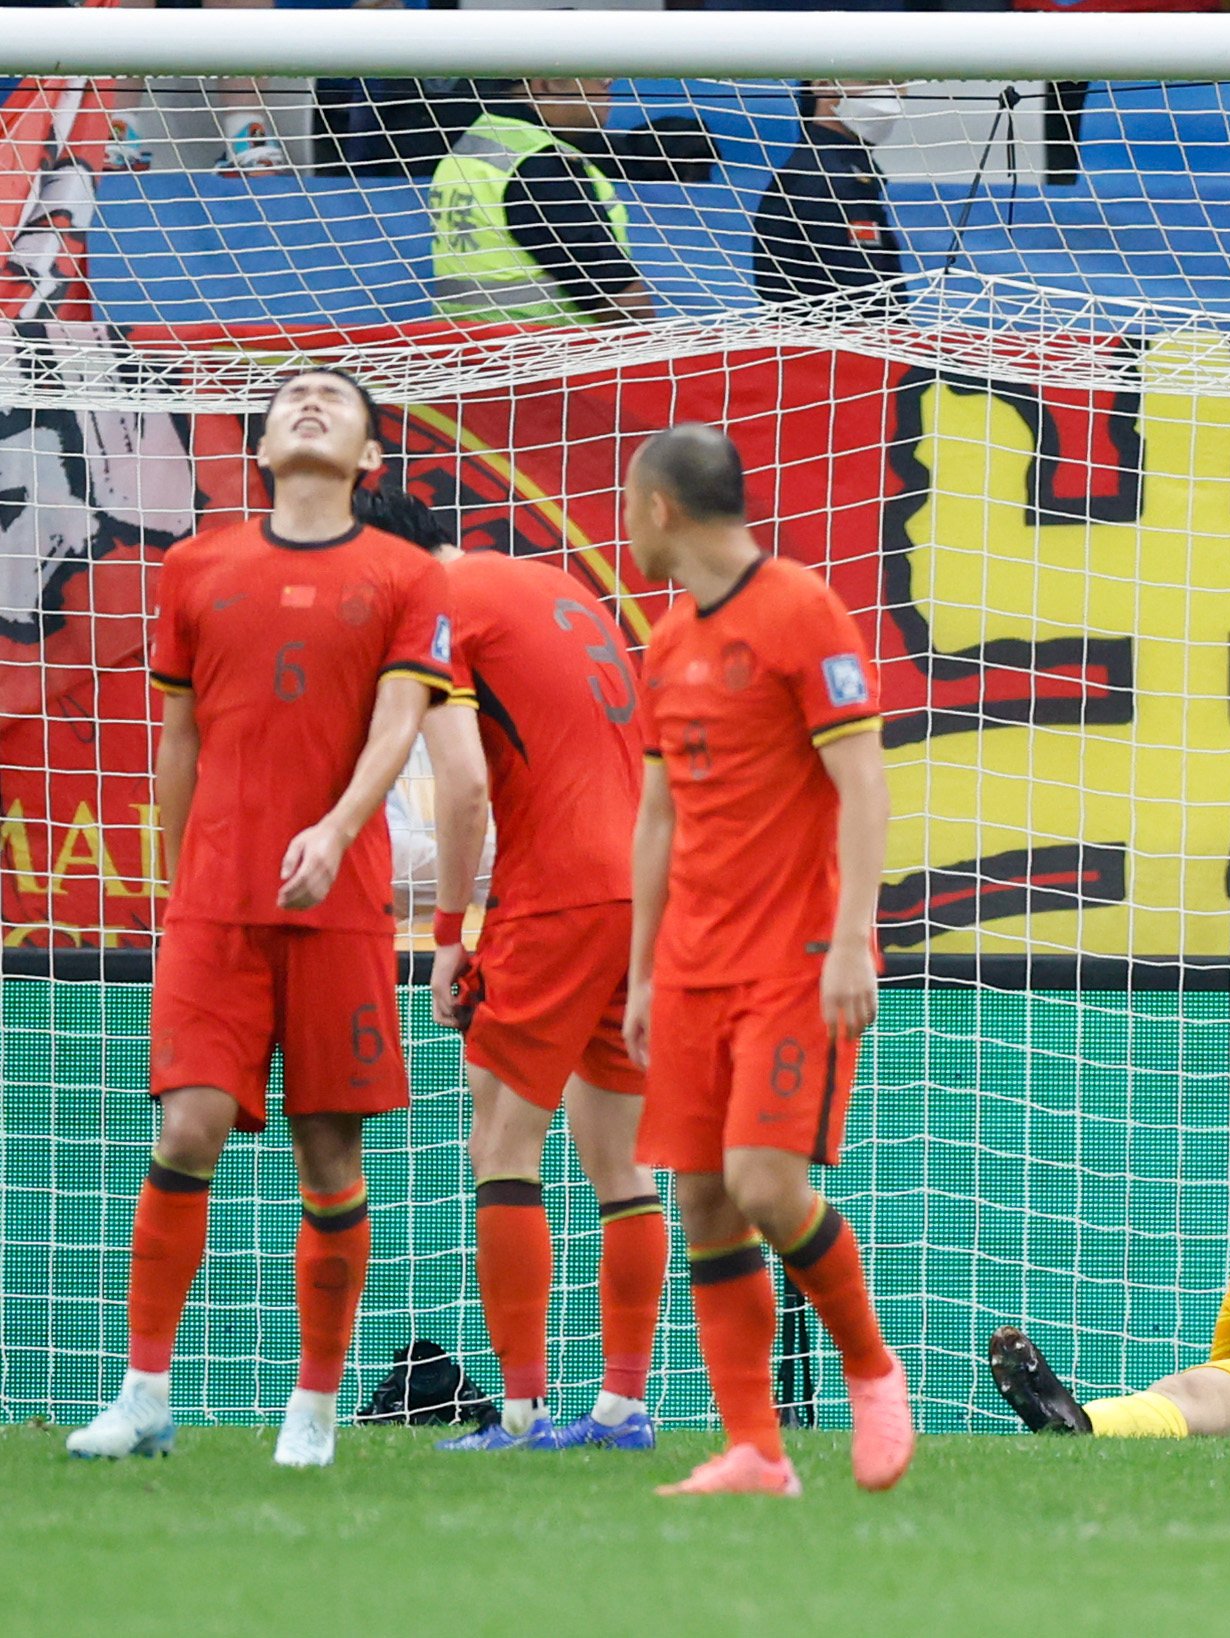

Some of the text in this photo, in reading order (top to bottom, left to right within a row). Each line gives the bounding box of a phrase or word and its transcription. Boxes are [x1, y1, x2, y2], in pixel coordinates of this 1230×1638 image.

[274, 641, 306, 702] 6
[554, 598, 636, 724] 3
[352, 1004, 384, 1066] 6
[770, 1036, 805, 1098] 8
